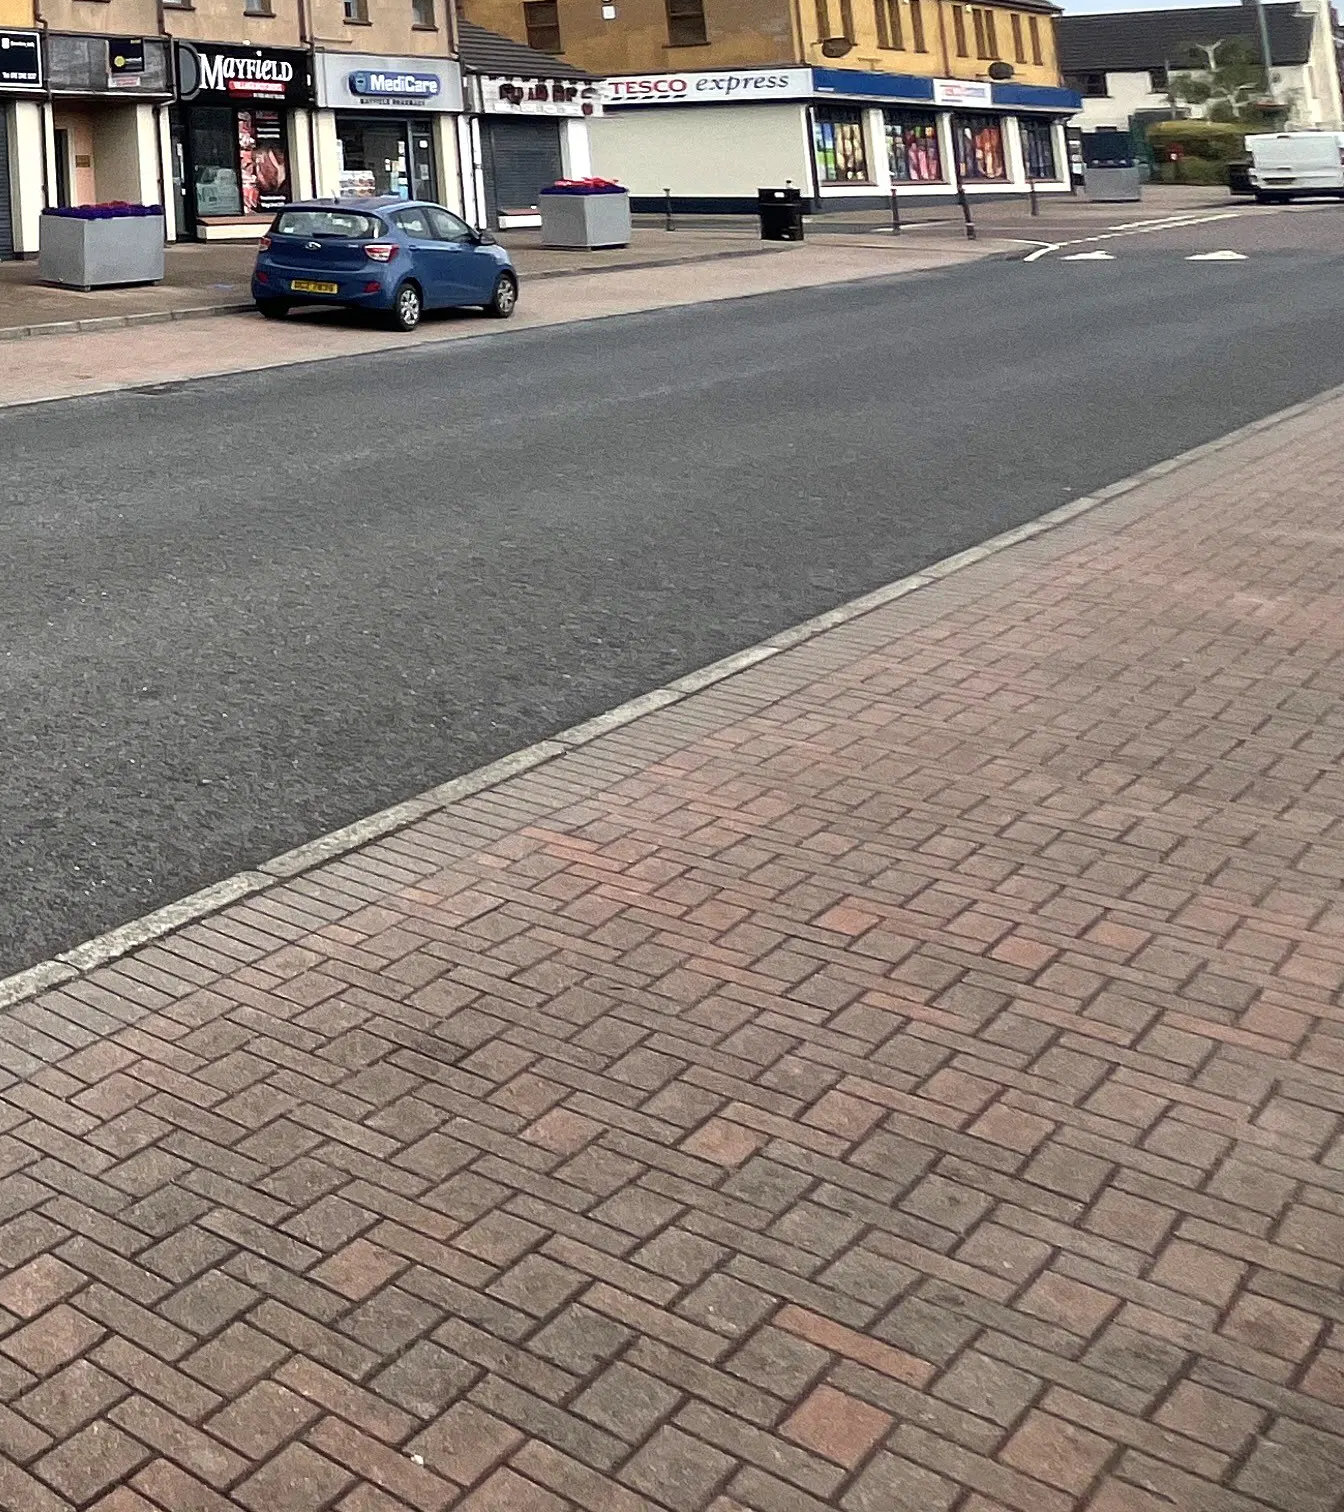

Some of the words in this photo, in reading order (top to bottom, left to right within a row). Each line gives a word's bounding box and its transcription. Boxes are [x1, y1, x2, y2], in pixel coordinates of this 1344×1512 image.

[370, 74, 438, 94] MediCare
[608, 79, 687, 94] TESCO
[695, 74, 789, 95] express
